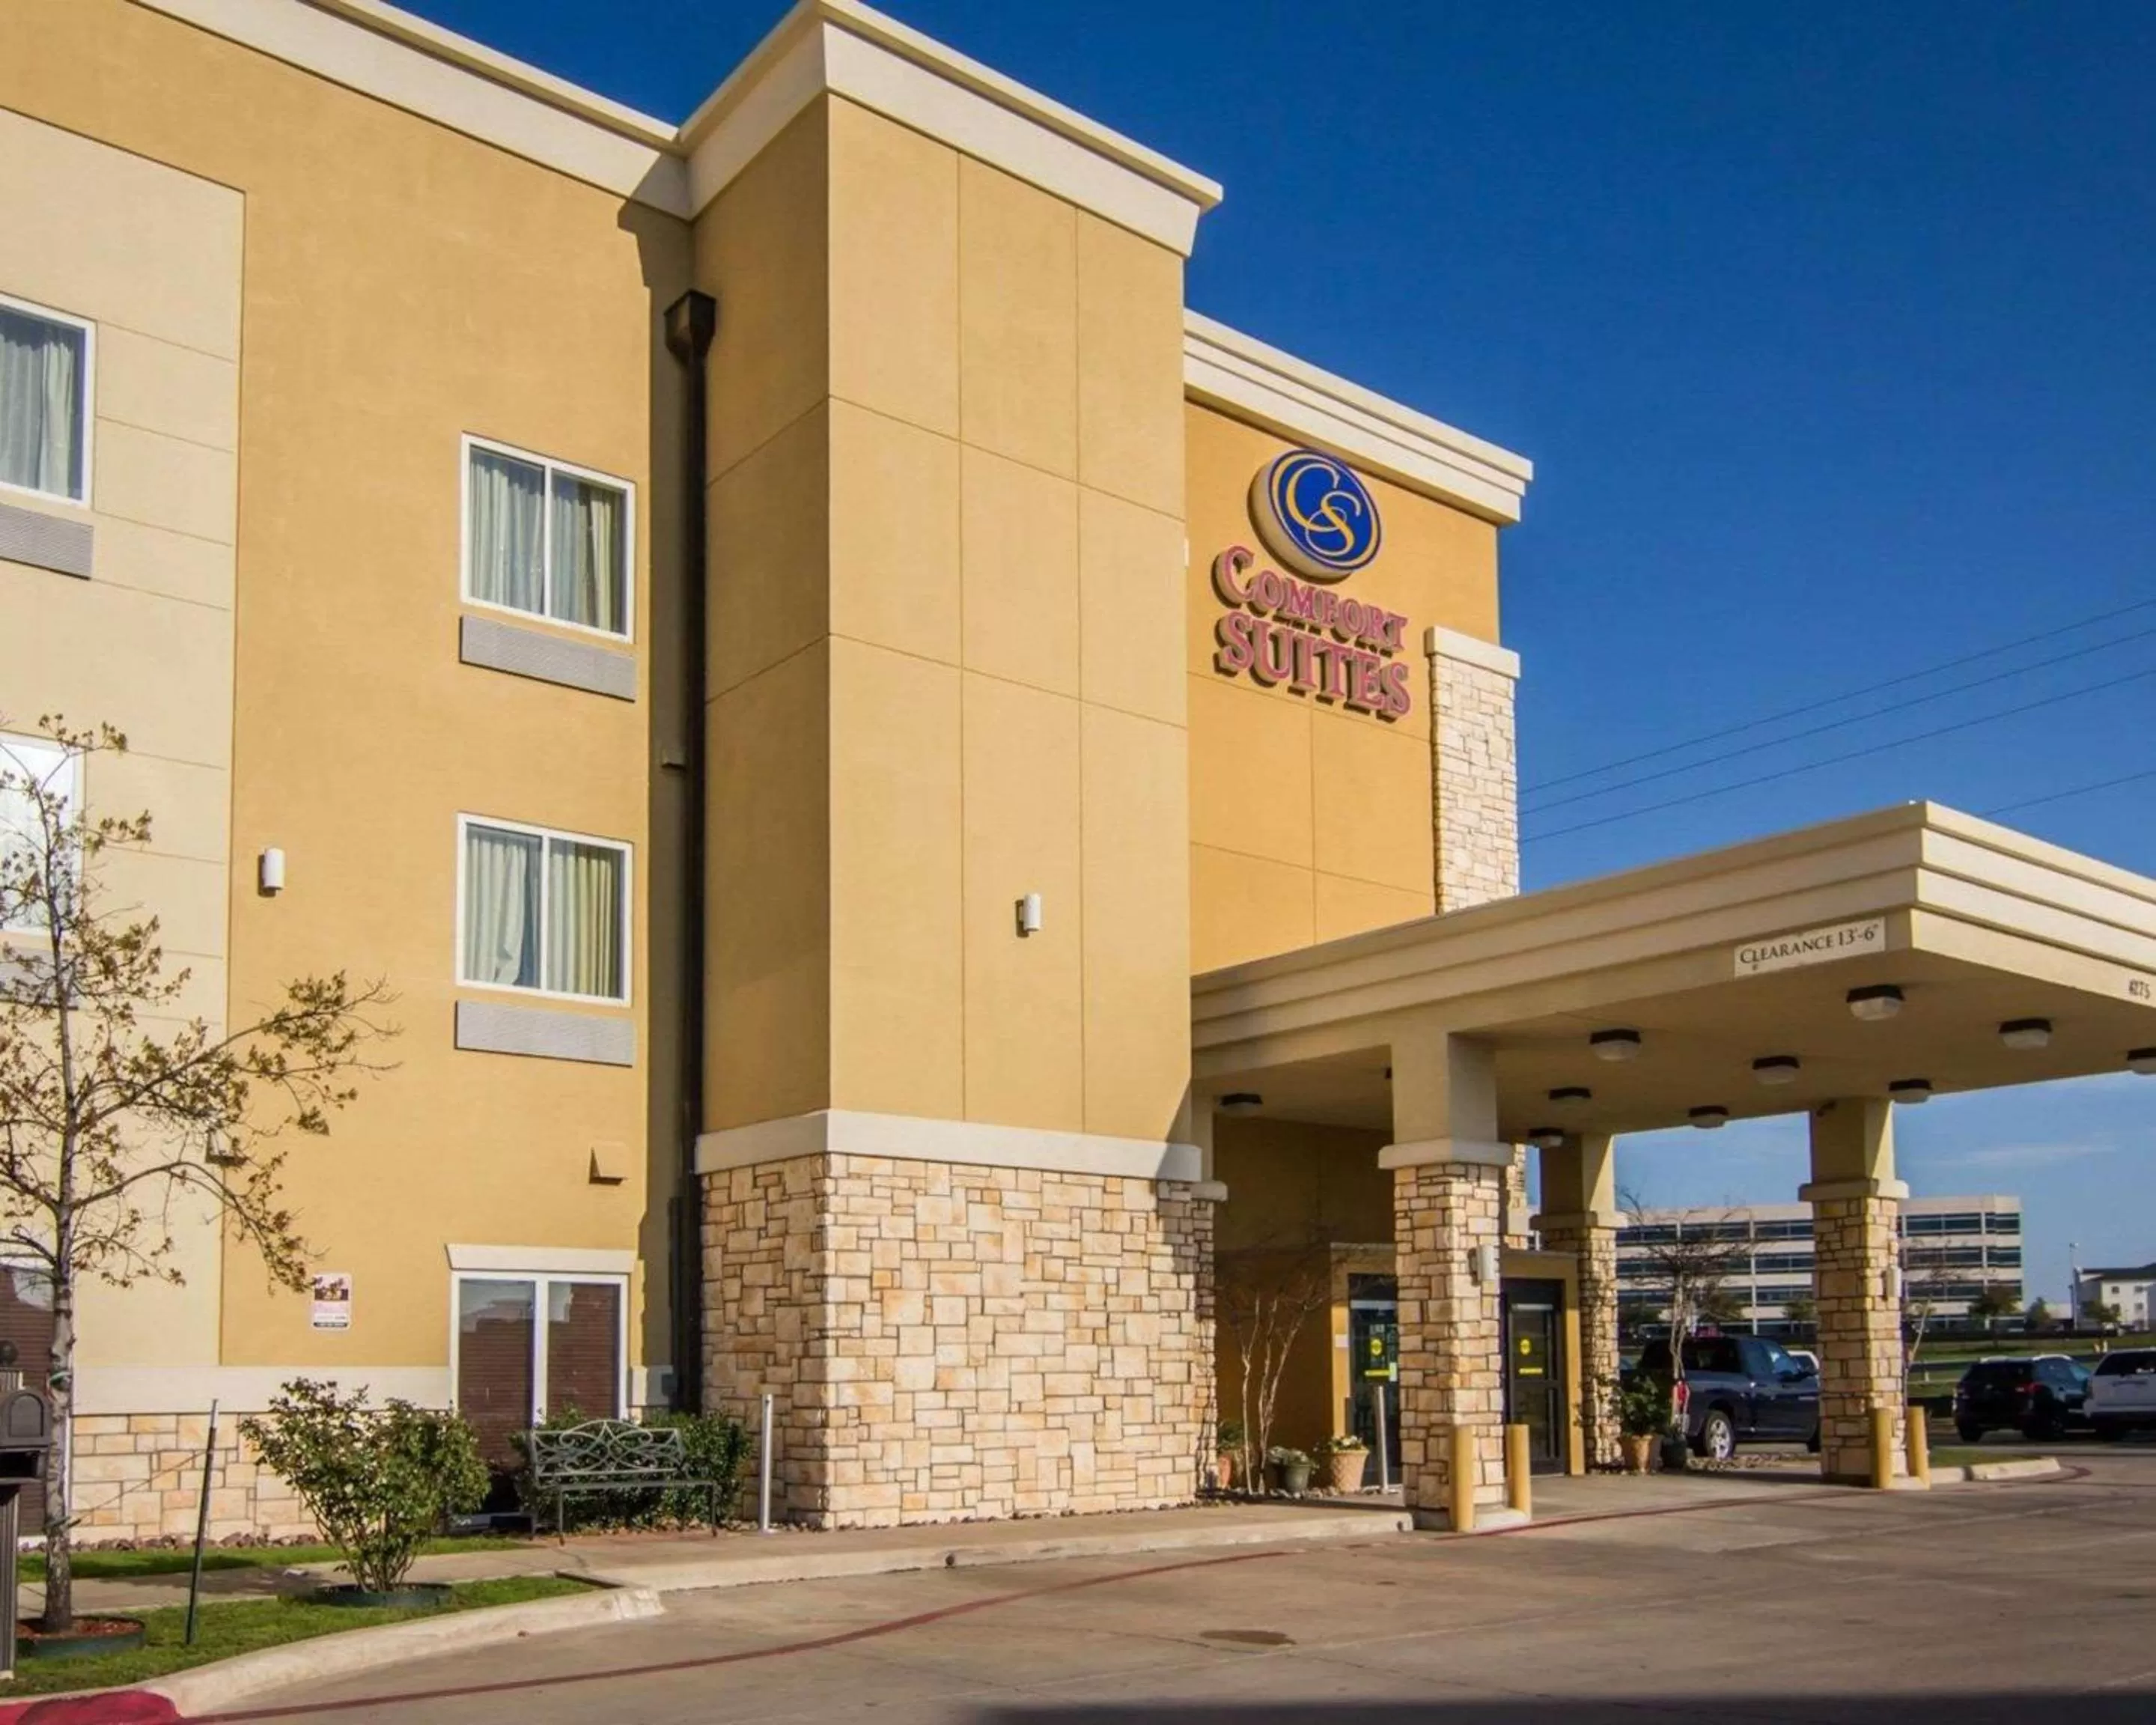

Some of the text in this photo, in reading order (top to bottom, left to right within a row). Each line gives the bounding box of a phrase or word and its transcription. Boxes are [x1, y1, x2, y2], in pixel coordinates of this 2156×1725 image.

[1219, 545, 1409, 651] COMFORT
[1220, 610, 1411, 717] SUITES
[1740, 934, 1834, 964] CLEARANCE
